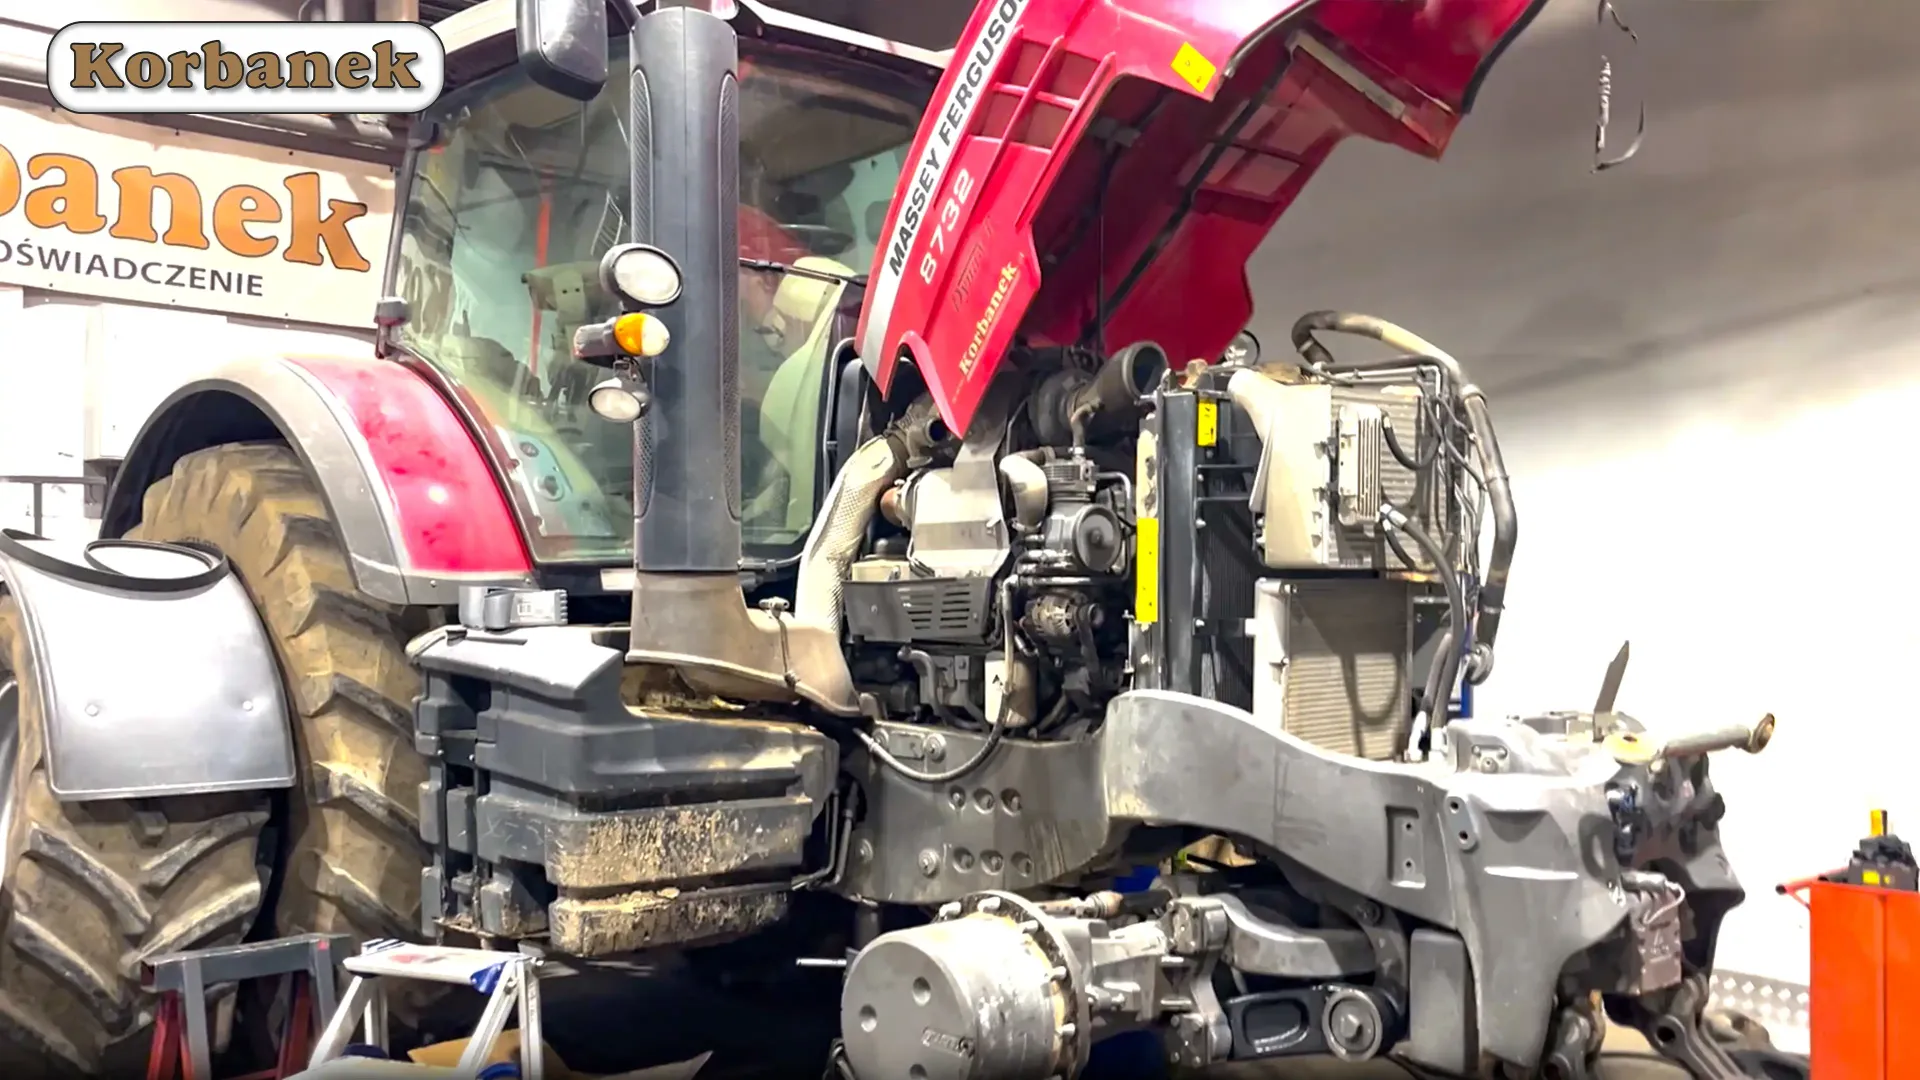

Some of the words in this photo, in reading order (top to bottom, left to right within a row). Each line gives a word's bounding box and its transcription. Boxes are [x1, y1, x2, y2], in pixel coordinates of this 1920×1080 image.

[889, 148, 940, 276] MASSEY
[938, 0, 1024, 147] FERGUSO
[0, 143, 371, 273] anek
[919, 168, 975, 285] 8732
[958, 260, 1019, 376] Korbanek
